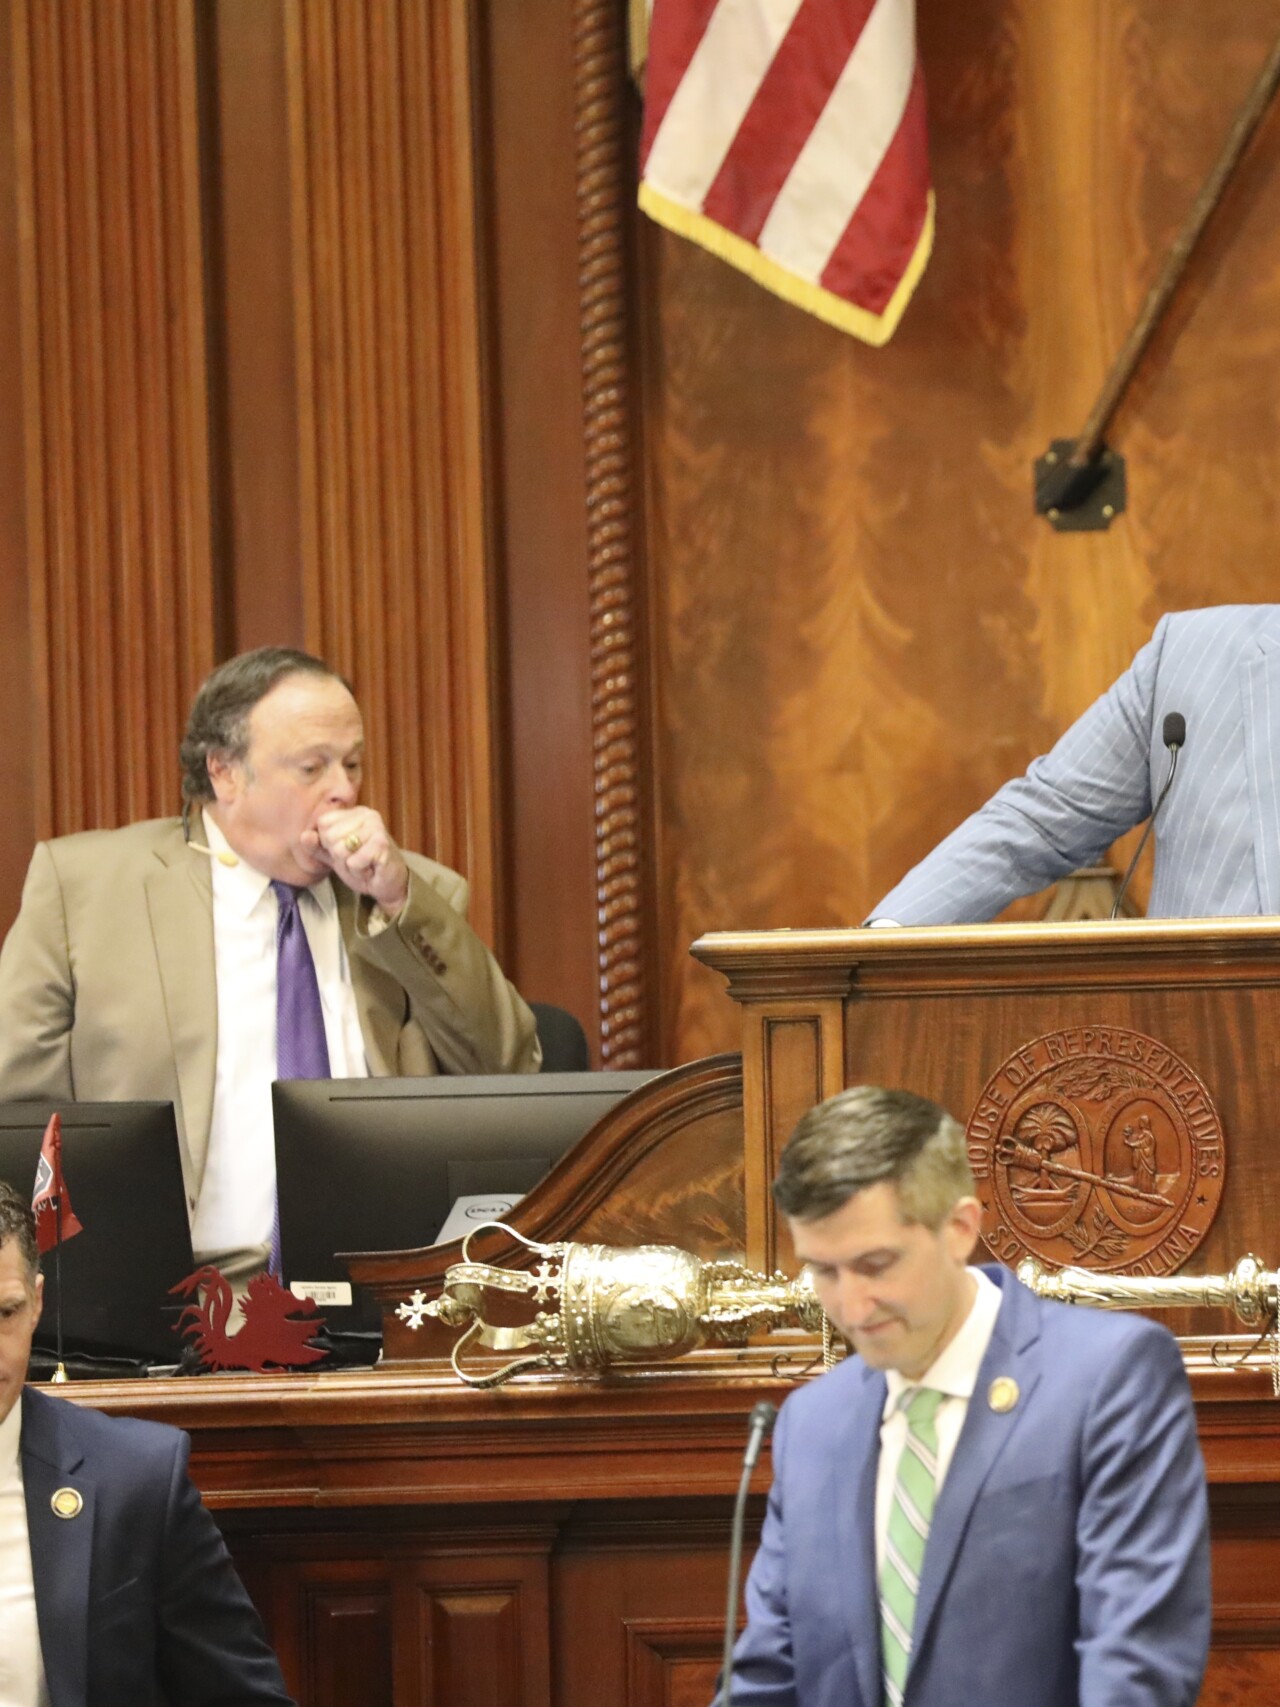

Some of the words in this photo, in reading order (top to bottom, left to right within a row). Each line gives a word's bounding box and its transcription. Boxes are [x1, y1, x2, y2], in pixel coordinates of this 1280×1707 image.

[968, 1088, 1009, 1179] HOUSE
[1004, 1052, 1036, 1086] OF
[1043, 1029, 1219, 1179] REPRESENTATIVES
